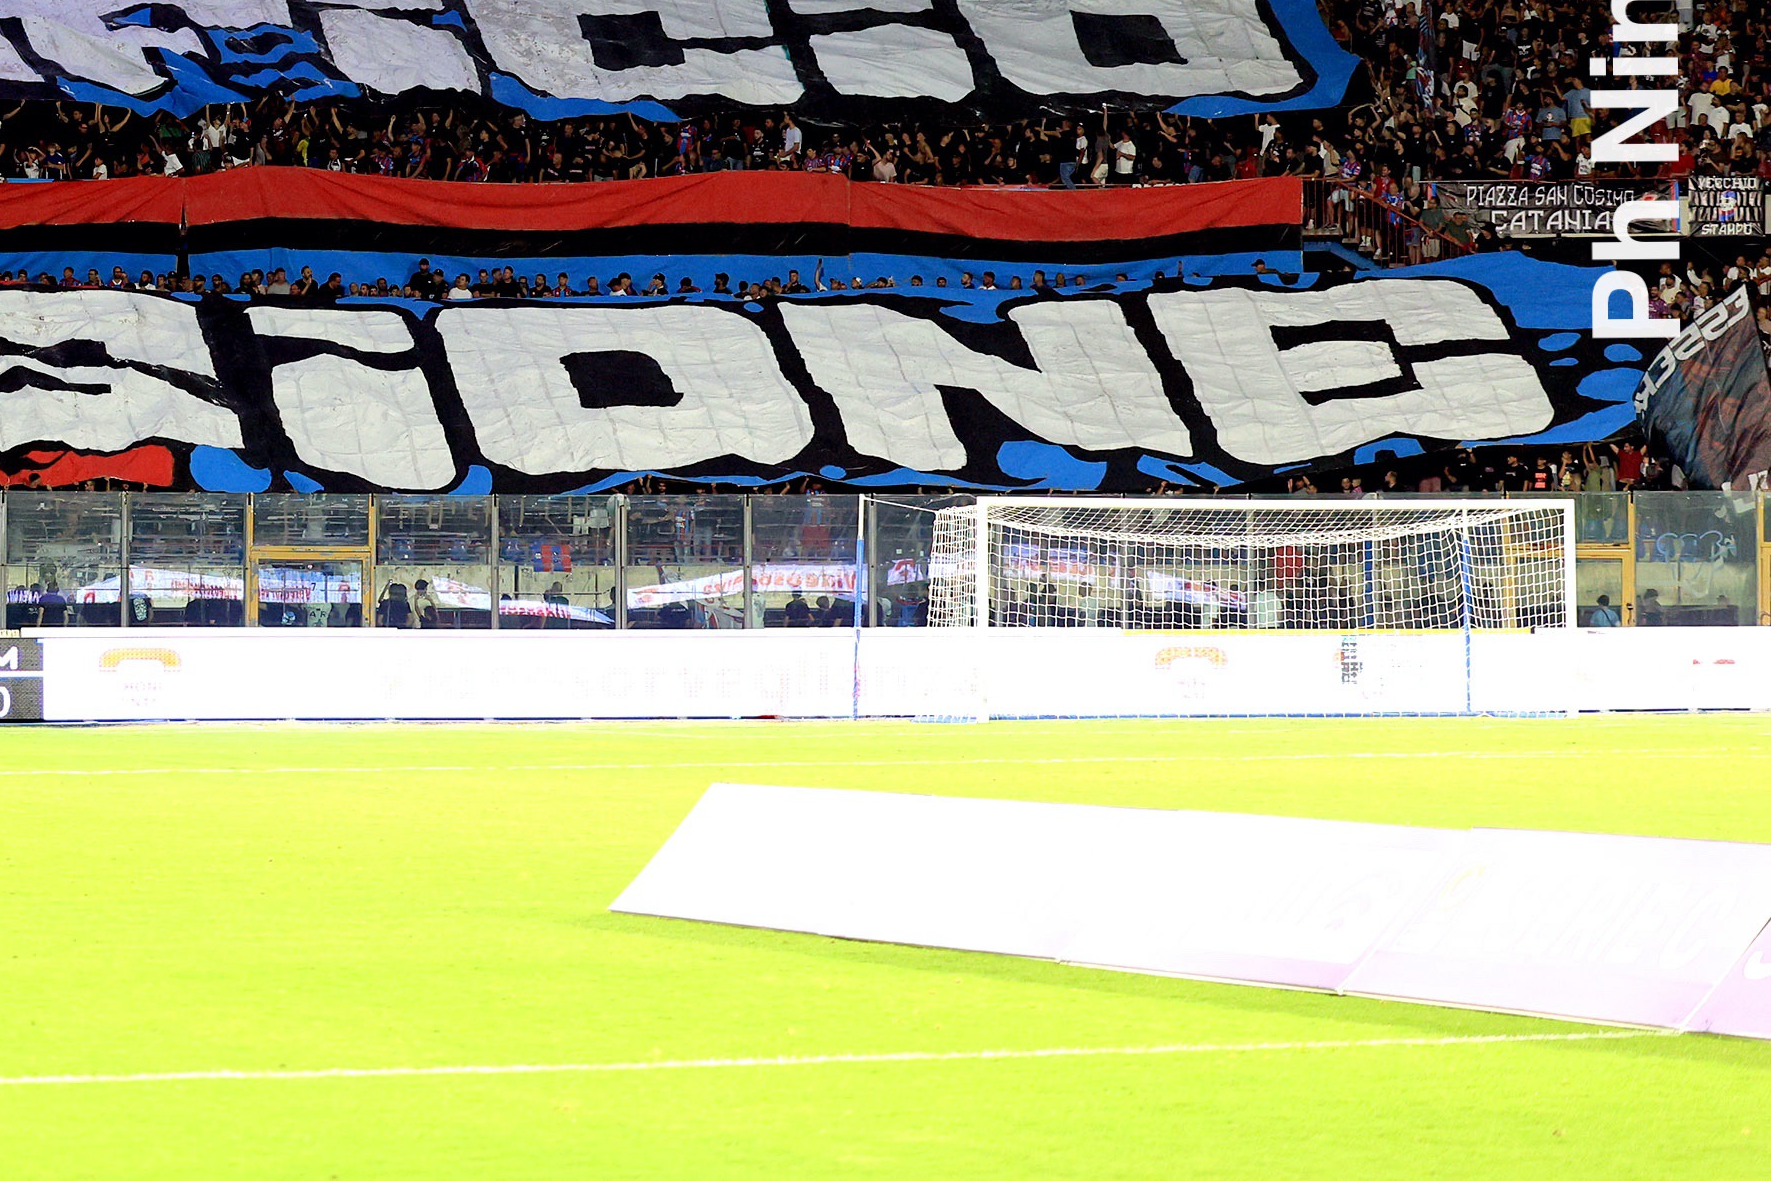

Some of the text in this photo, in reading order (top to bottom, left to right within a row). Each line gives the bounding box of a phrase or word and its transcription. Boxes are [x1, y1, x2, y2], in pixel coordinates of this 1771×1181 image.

[1467, 185, 1528, 206] PIAZZA
[1535, 185, 1568, 206] SAN
[1491, 209, 1611, 235] CATANIA
[1701, 222, 1753, 235] STAMPO
